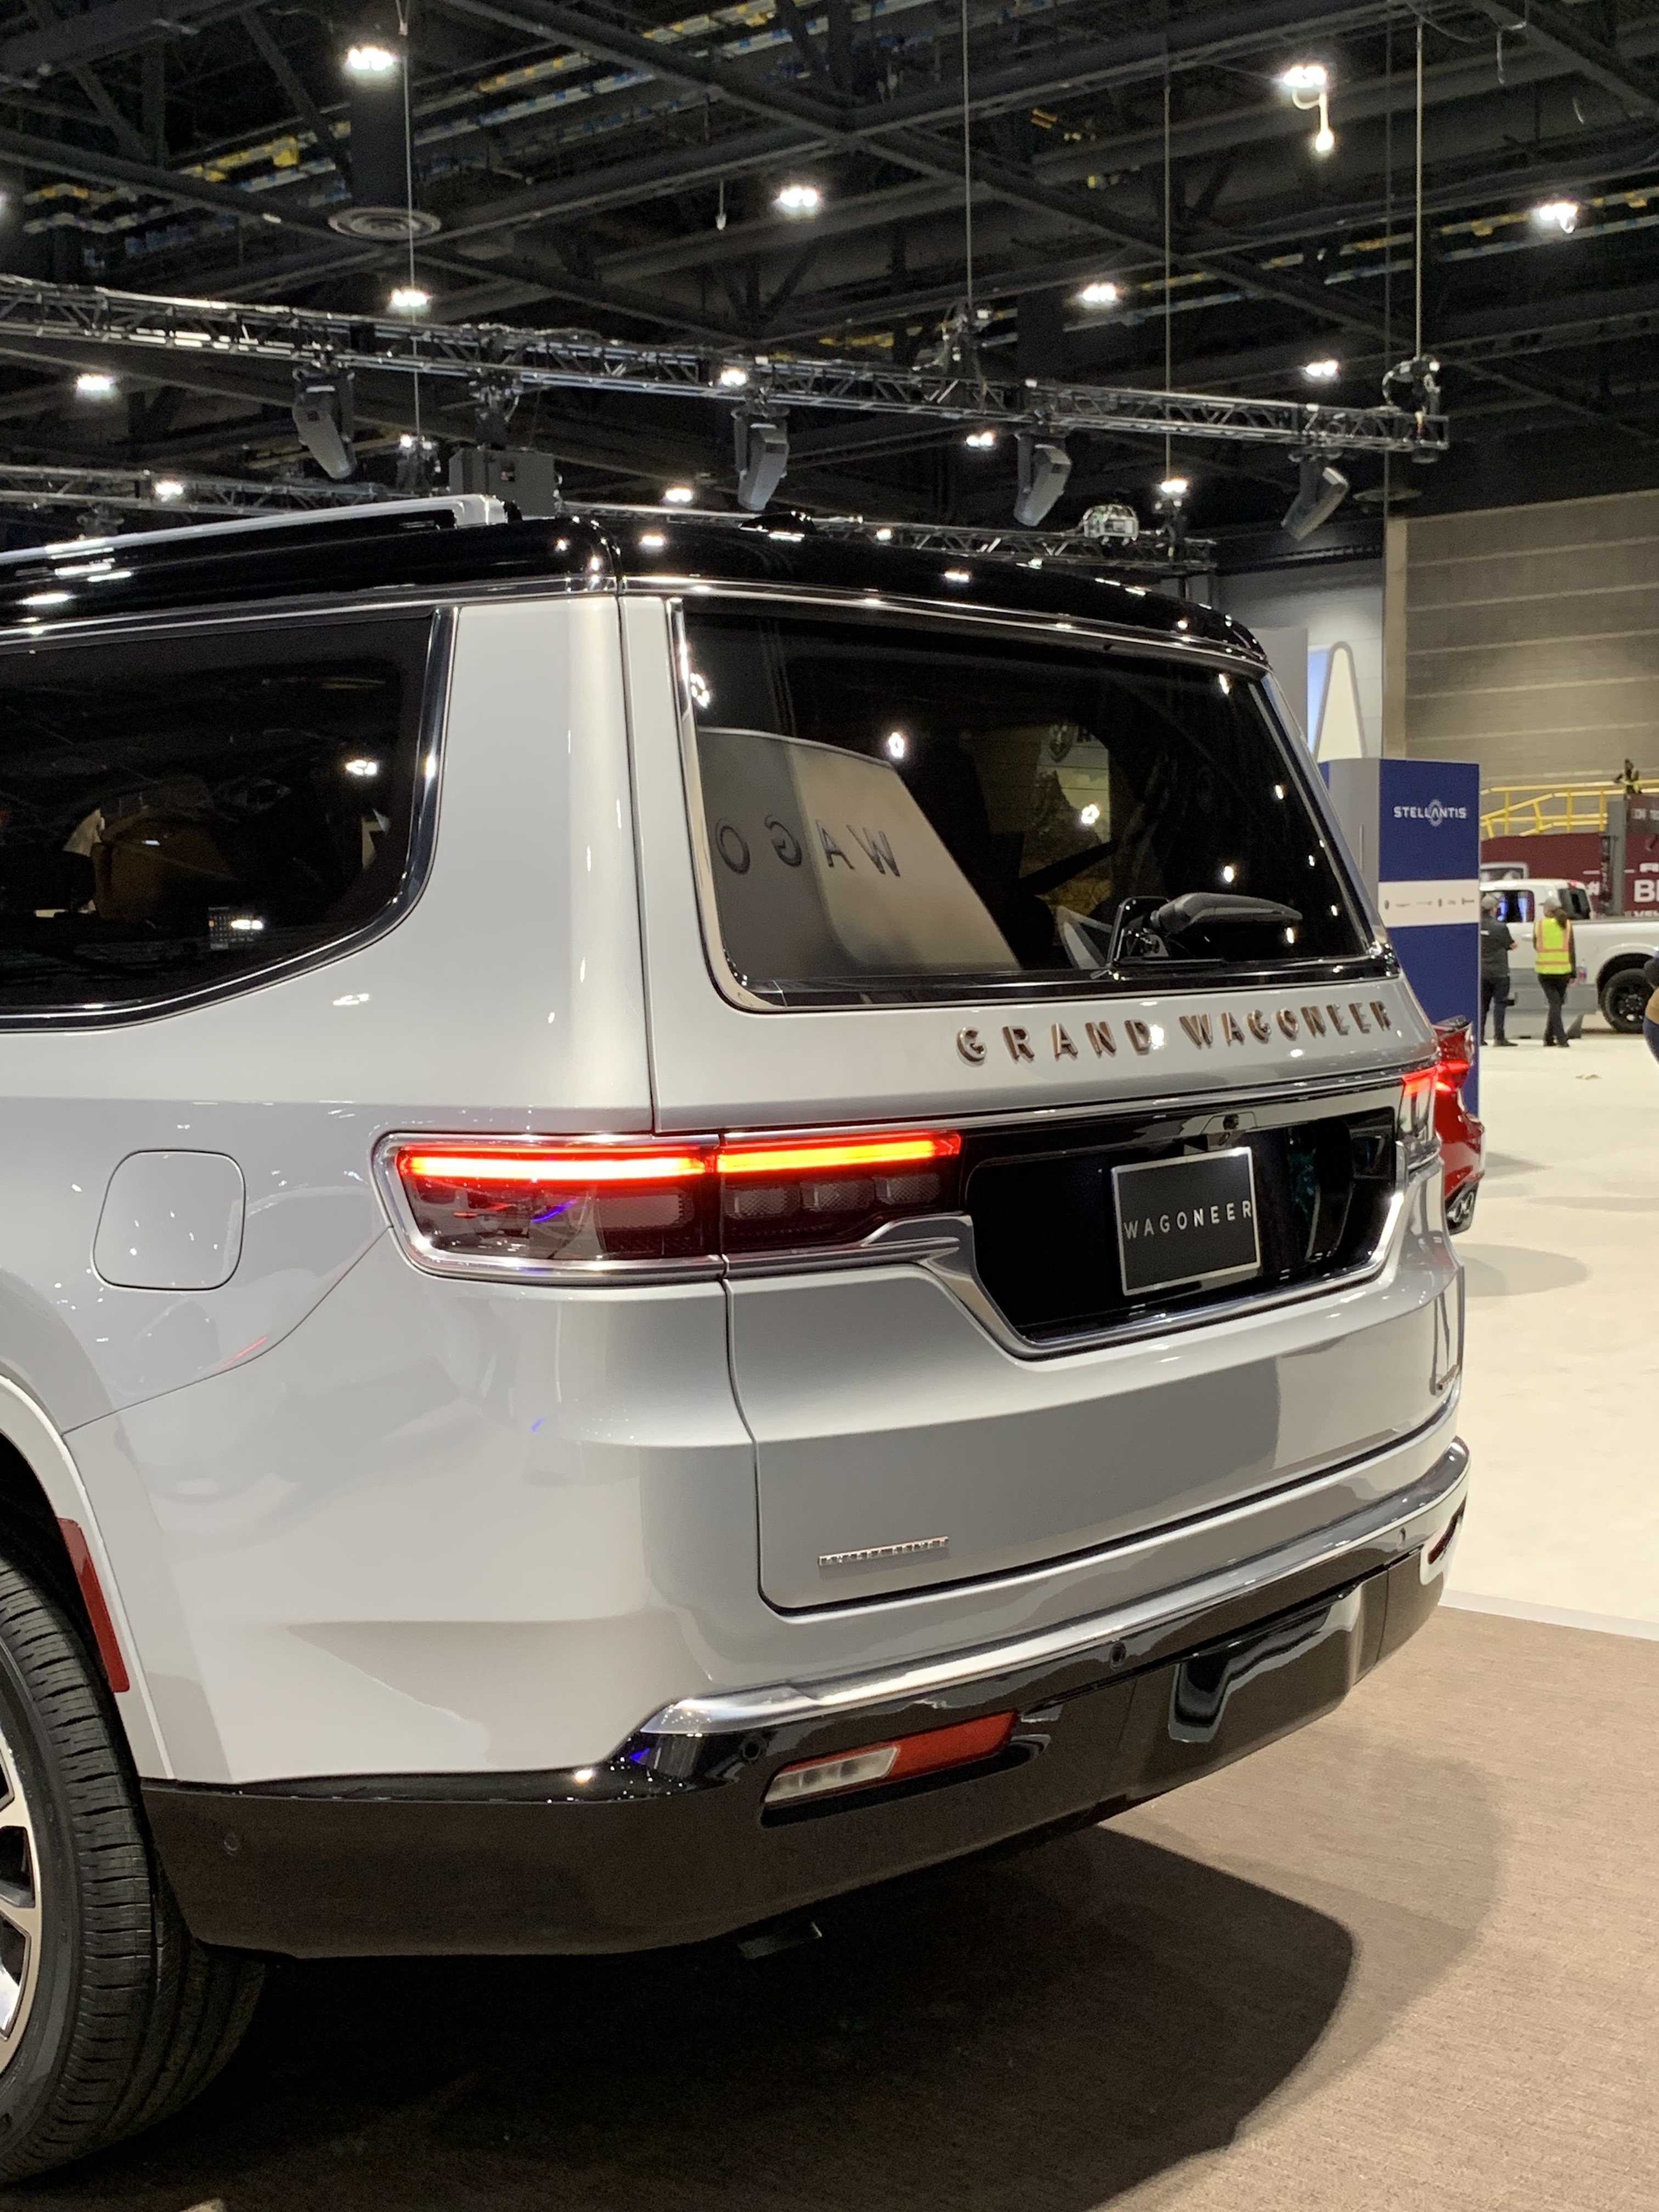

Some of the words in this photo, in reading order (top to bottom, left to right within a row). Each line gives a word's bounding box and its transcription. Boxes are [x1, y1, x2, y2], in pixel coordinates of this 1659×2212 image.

[1393, 806, 1466, 819] STELLANTIS
[956, 1019, 1153, 1063] GRAND
[1179, 1000, 1392, 1049] WAGONEER
[1125, 1200, 1251, 1239] WAGONEER
